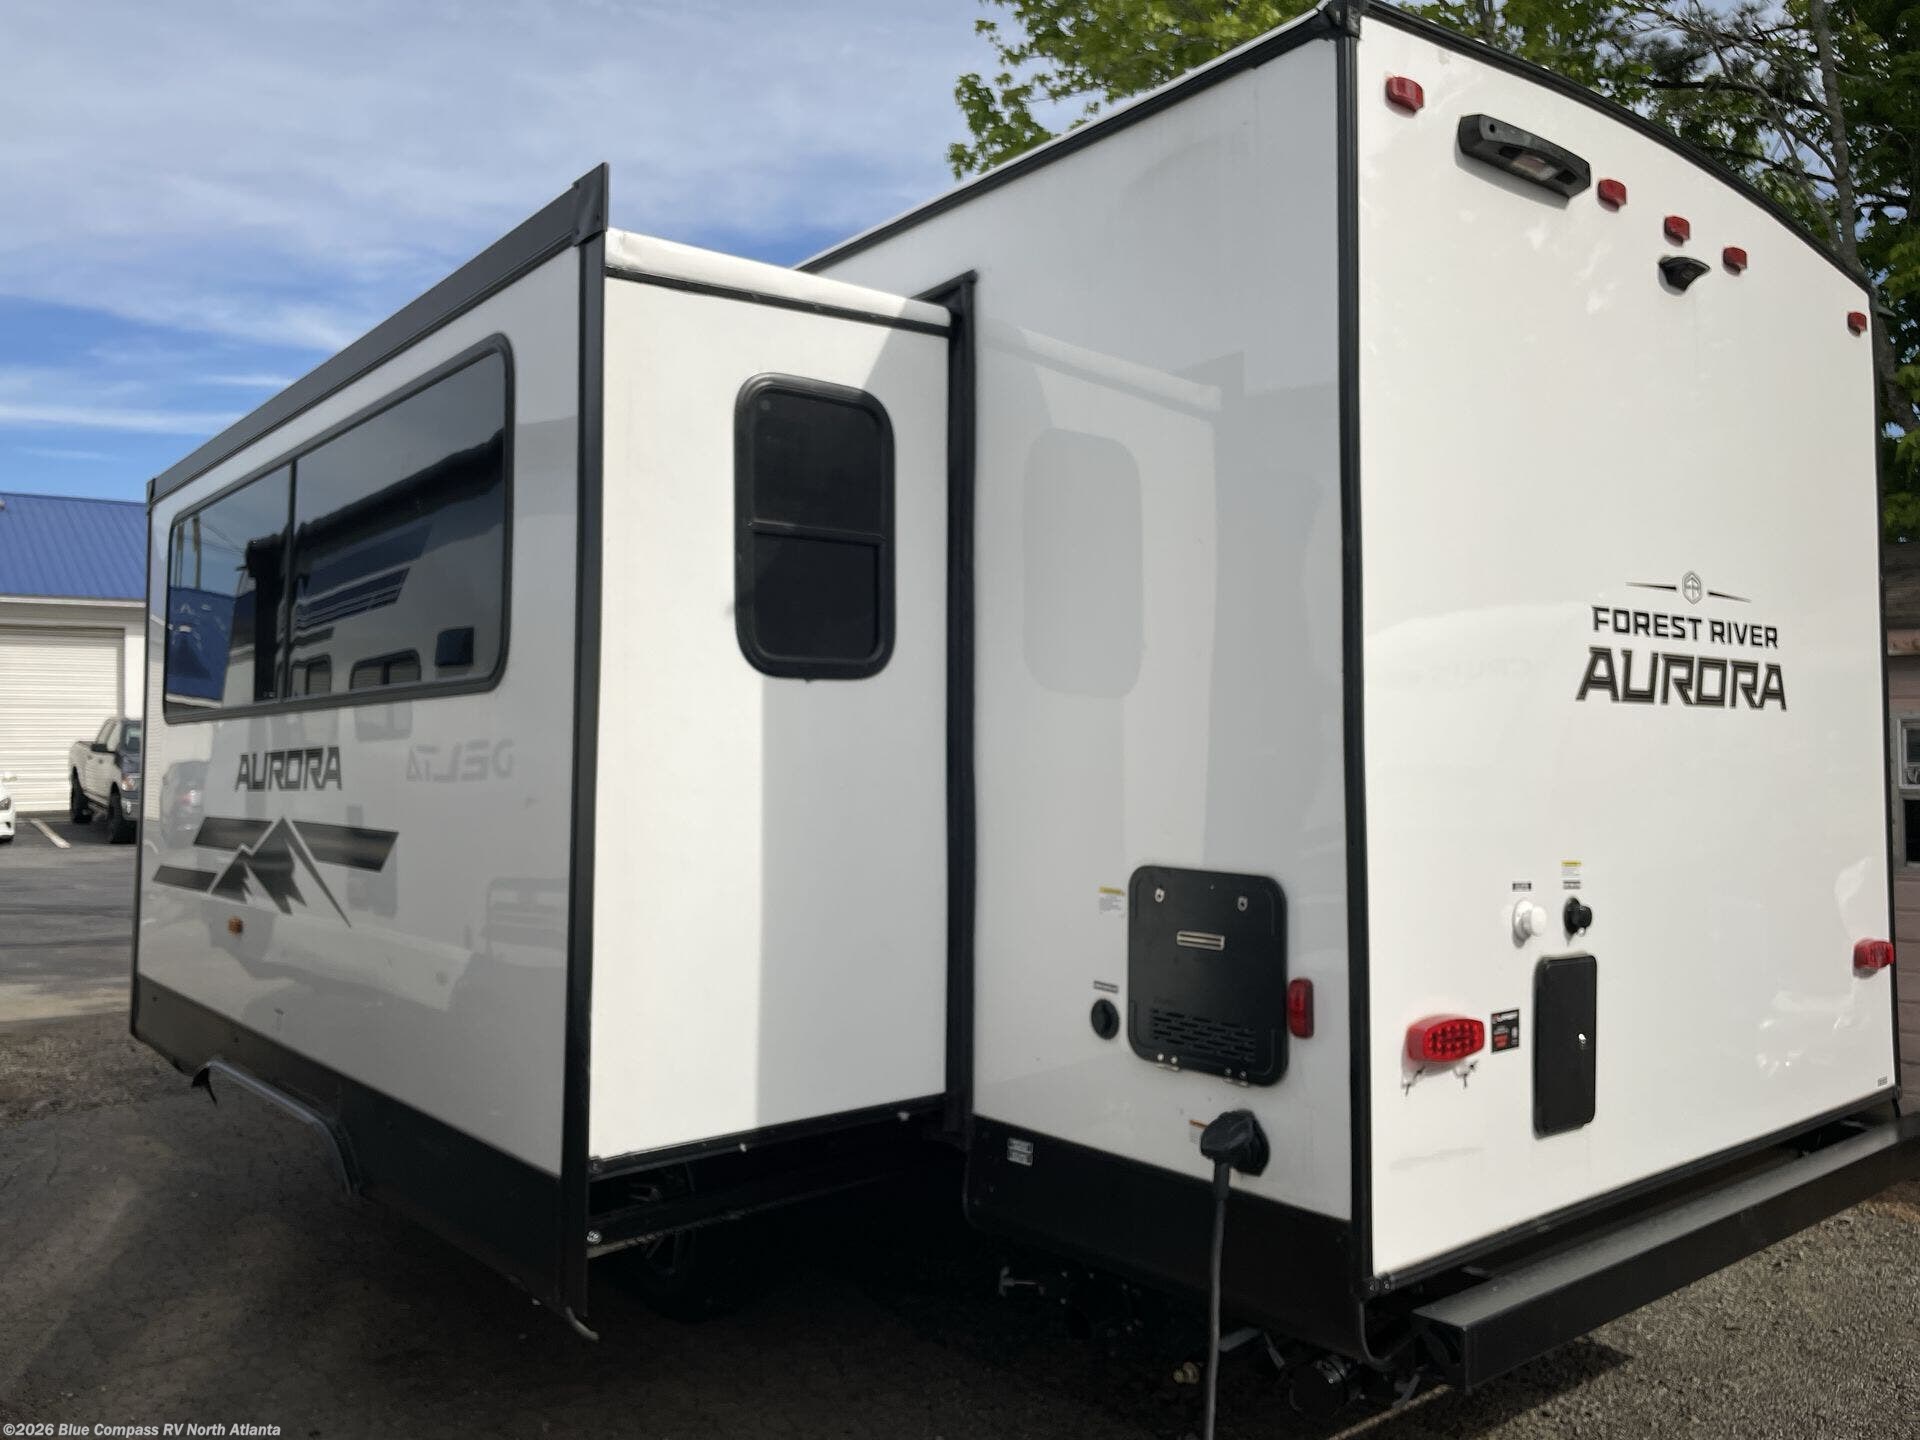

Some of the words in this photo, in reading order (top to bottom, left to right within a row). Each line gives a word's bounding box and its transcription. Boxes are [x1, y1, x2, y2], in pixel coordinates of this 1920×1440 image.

[1591, 604, 1702, 641] FOREST
[1708, 619, 1779, 648] RIVER
[1575, 645, 1787, 711] AURORA
[235, 745, 342, 792] AURORA
